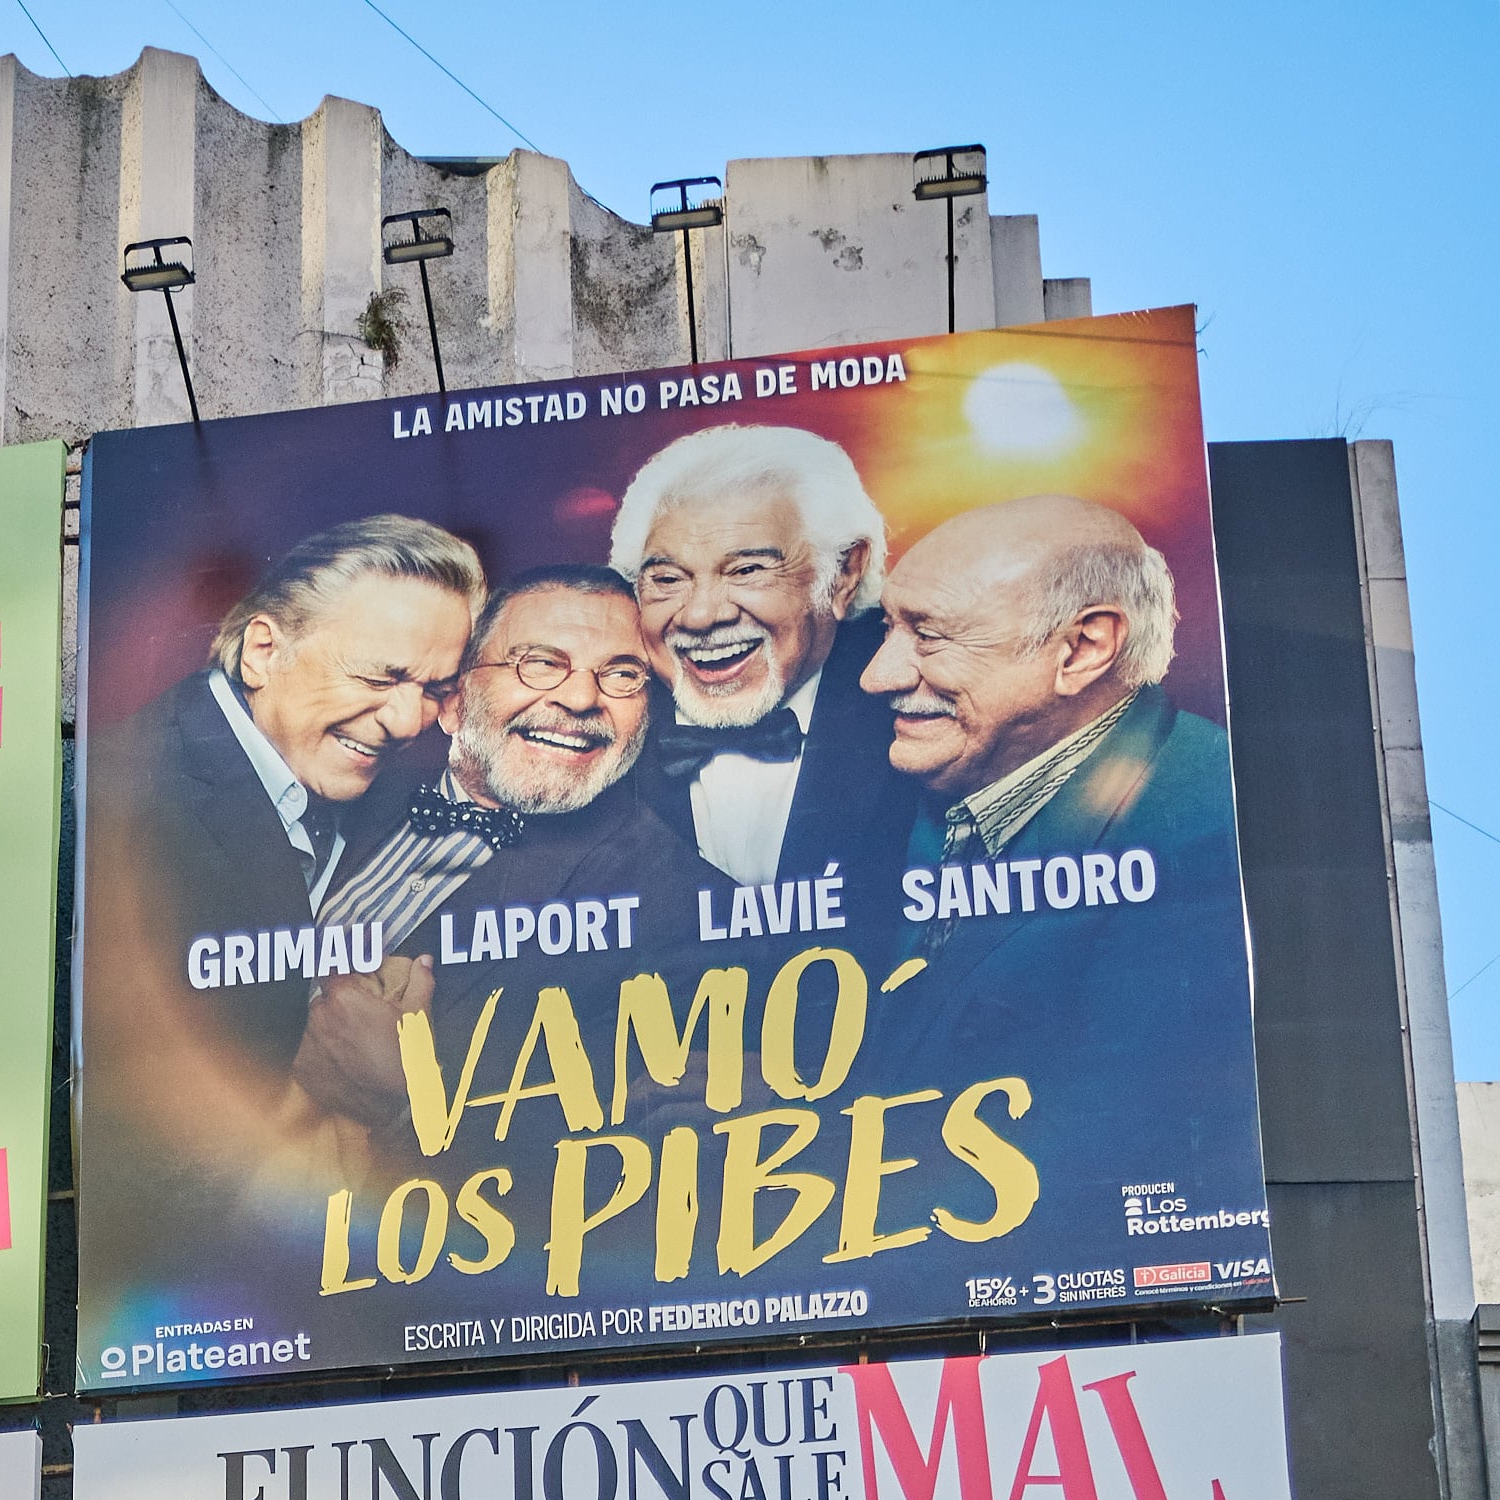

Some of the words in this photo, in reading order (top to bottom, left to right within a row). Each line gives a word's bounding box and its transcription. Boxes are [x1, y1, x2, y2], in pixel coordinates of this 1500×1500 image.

[393, 407, 433, 438] LA
[444, 393, 588, 433] AMISTAD
[600, 386, 646, 416] NO
[659, 373, 741, 409] PASA
[754, 367, 797, 397] DE
[810, 353, 907, 390] MODA
[186, 921, 384, 989] GRIMAU
[440, 897, 640, 966] LAPORT
[697, 861, 845, 941] LAVIÉ
[902, 849, 1156, 926] SANTORO
[318, 1168, 517, 1297] LOS
[546, 1076, 1040, 1297] PIBES
[1121, 1182, 1174, 1196] PRODUCEN
[1147, 1197, 1187, 1214] Los
[131, 1332, 310, 1374] Plateanet
[403, 1315, 486, 1351] ESCRITA
[488, 1314, 504, 1344] Y
[509, 1308, 595, 1344] DIRIGIDA
[601, 1305, 643, 1337] POR
[647, 1296, 759, 1335] FEDERICO
[765, 1289, 868, 1325] PALAZZO
[702, 1376, 835, 1460] QUE
